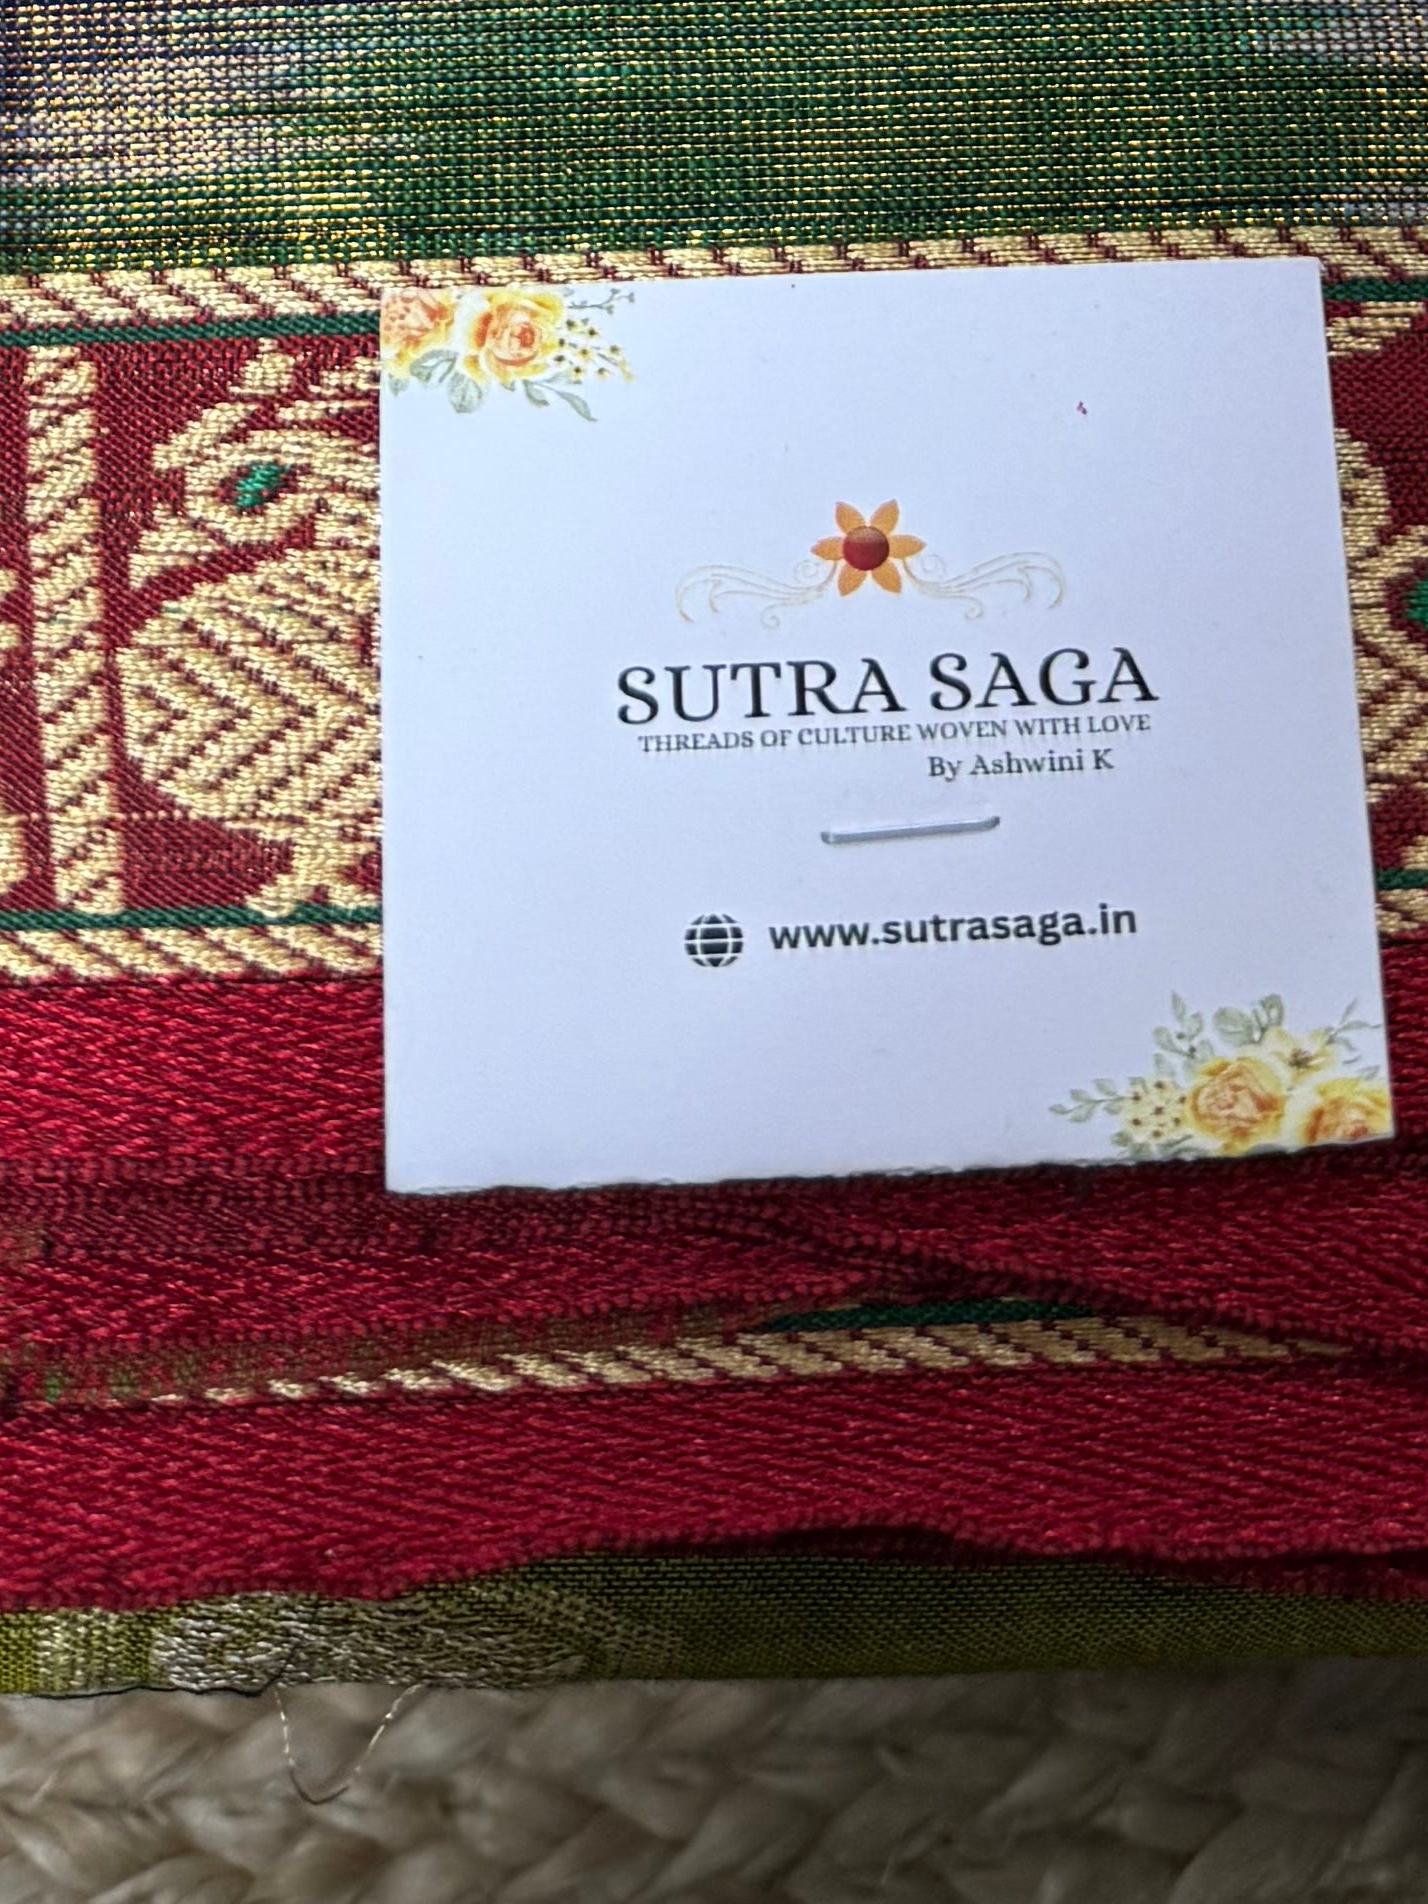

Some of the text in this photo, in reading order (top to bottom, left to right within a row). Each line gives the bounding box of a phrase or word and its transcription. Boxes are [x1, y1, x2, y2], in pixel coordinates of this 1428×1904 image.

[617, 648, 1159, 726] SUTRA SAGA
[638, 713, 1151, 754] THREADS OF CULTURE WOVEN WITH LOVE
[928, 748, 1115, 782] By Ashwini K
[768, 902, 1137, 951] www.sutrasaga.in
